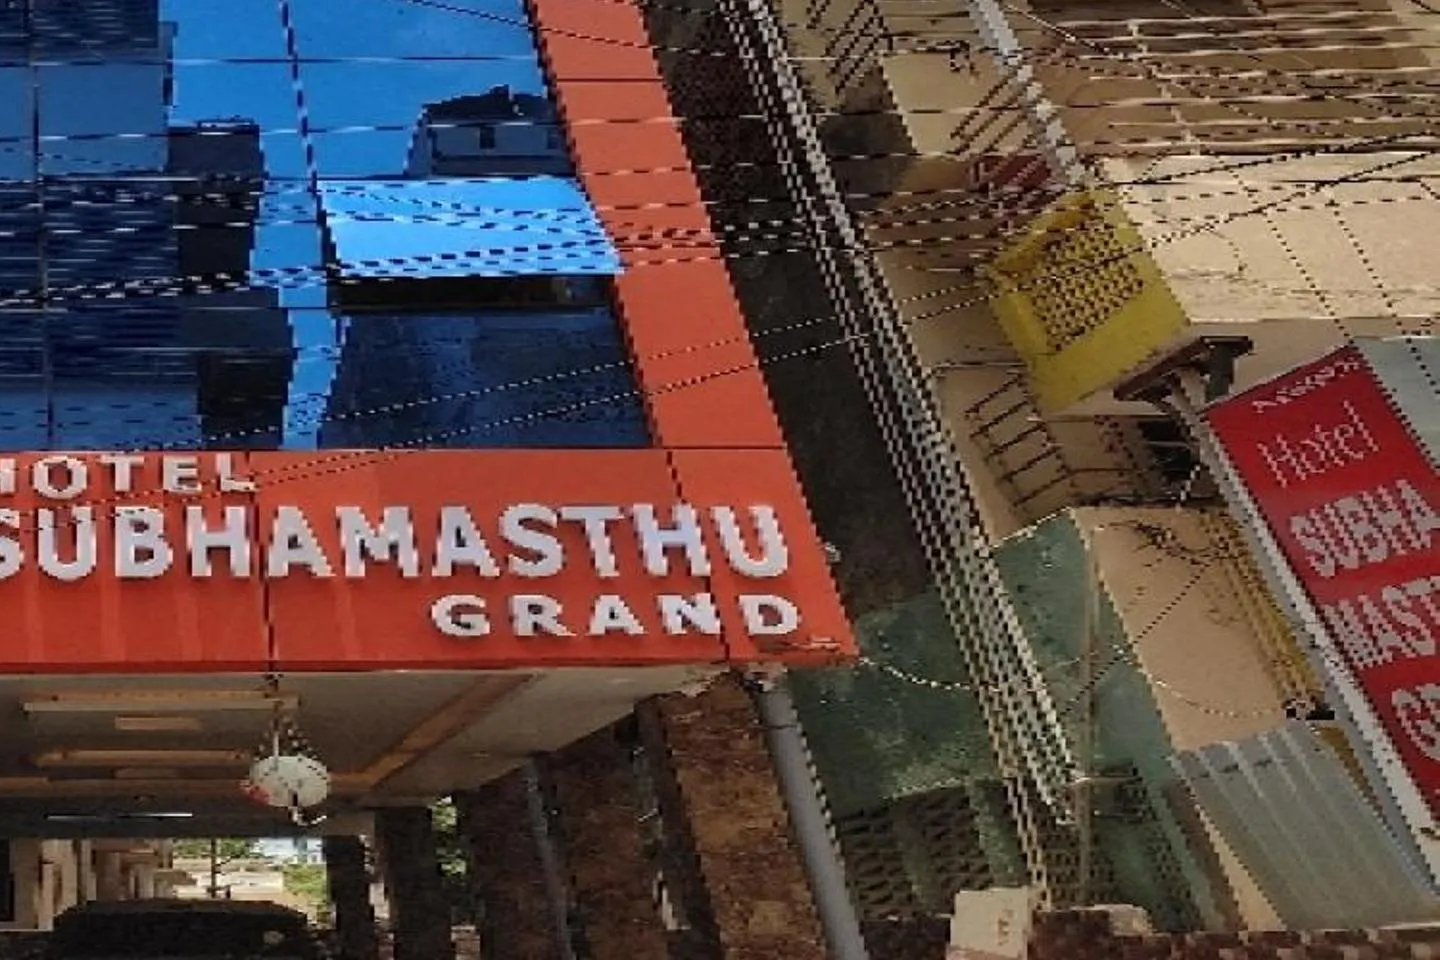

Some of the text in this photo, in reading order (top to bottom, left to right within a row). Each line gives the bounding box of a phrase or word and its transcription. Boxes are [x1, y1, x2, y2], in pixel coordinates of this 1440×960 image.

[1257, 399, 1380, 489] Hotel
[1290, 479, 1440, 578] SUBHA
[429, 593, 802, 637] GRAND
